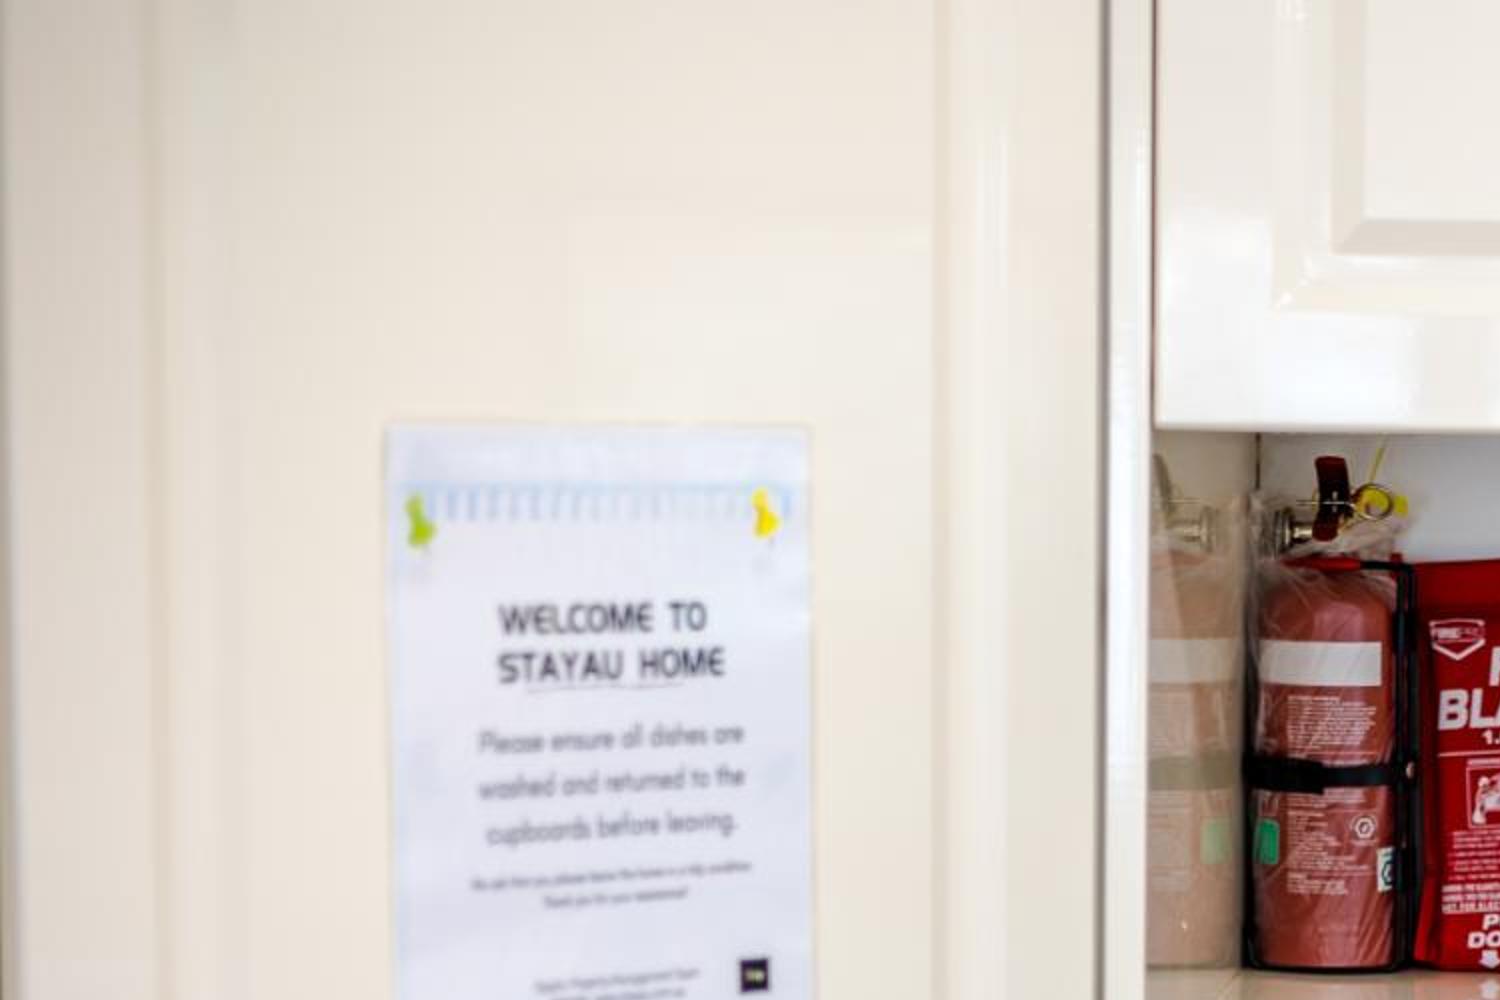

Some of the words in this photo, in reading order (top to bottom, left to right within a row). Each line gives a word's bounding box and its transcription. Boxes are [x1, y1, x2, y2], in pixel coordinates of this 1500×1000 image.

[498, 602, 654, 635] WELCOME
[669, 600, 708, 632] TO
[498, 650, 624, 684] STAYAU
[639, 646, 726, 678] HOME
[478, 728, 544, 754] Please
[550, 731, 615, 751] ensure
[621, 724, 644, 749] all
[650, 723, 708, 748] dishes
[714, 726, 744, 744] are
[478, 775, 557, 800] washed
[562, 771, 599, 796] and
[605, 766, 686, 792] returned
[691, 768, 710, 788] to
[715, 765, 745, 788] the
[486, 815, 591, 848] cupboards
[597, 811, 660, 837] before
